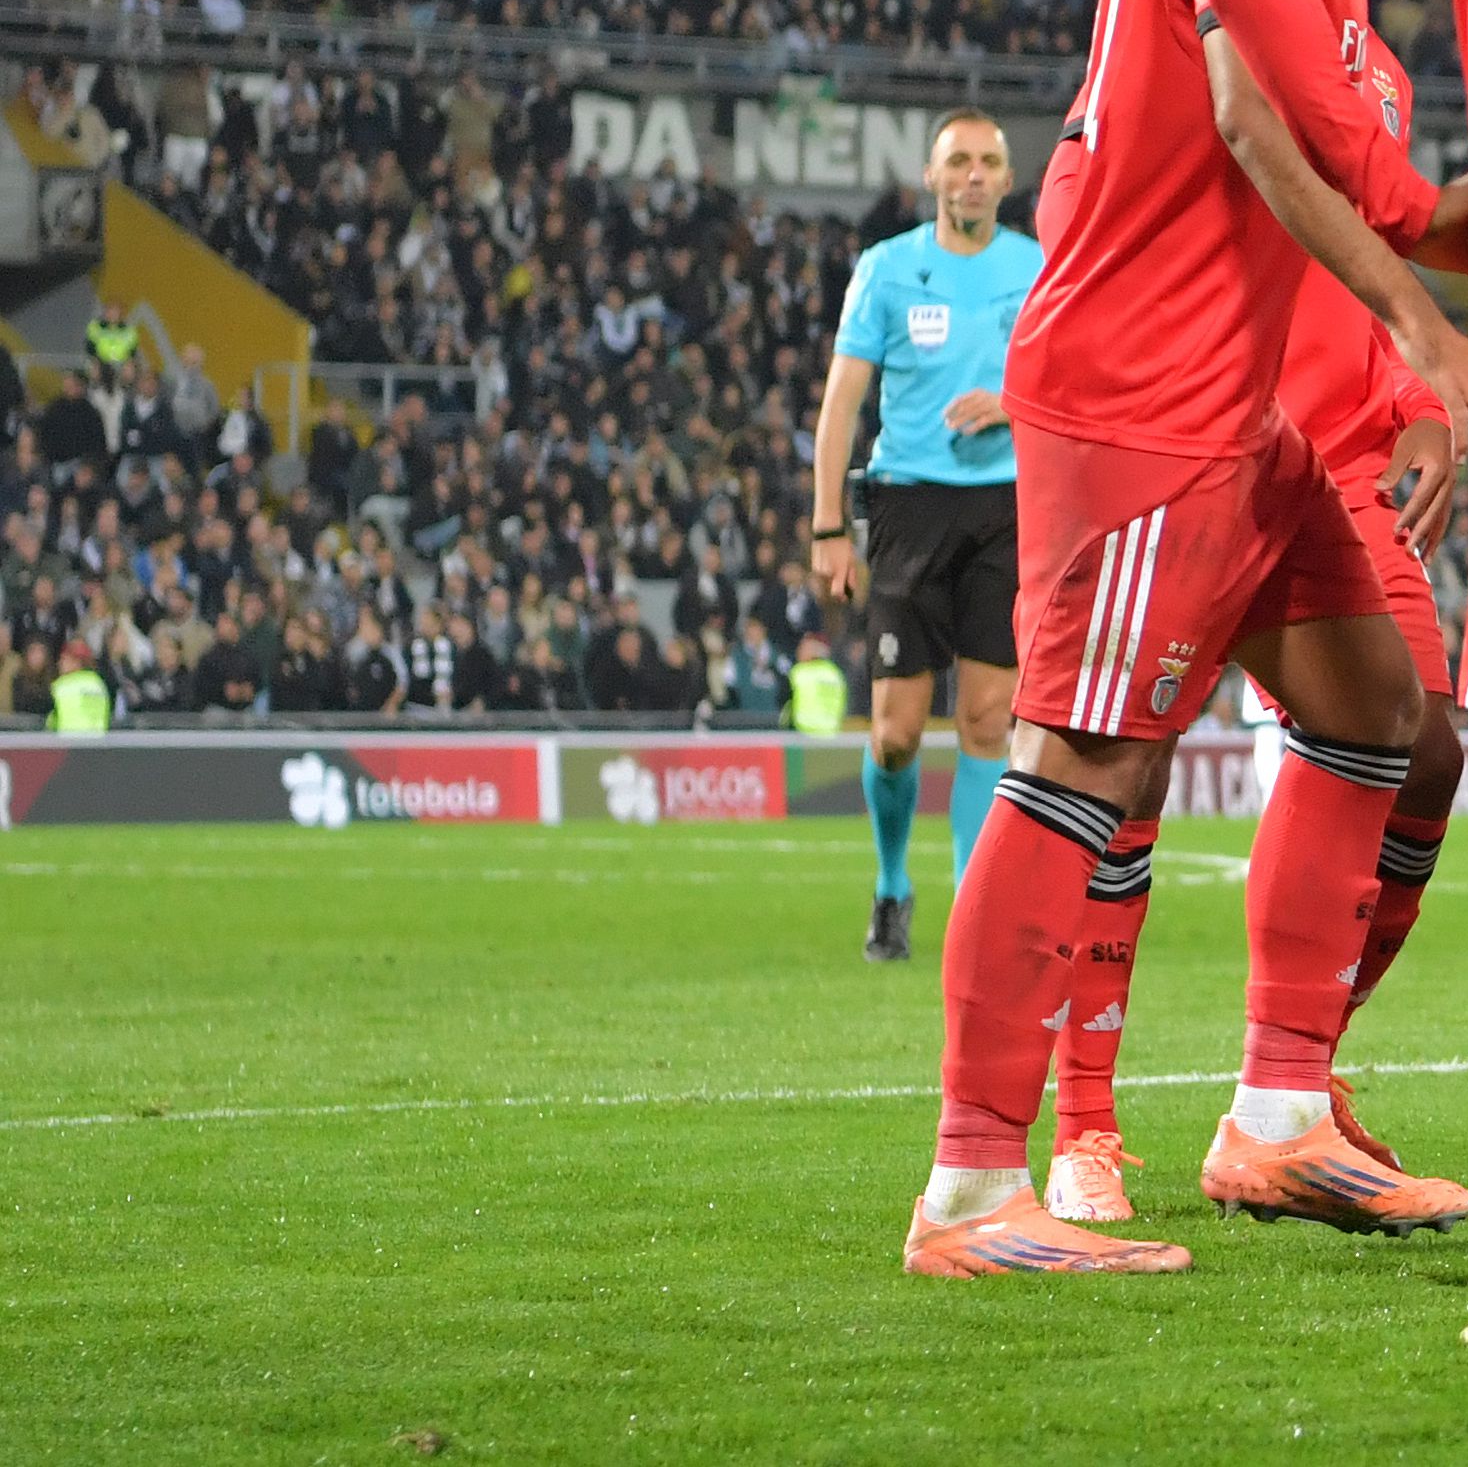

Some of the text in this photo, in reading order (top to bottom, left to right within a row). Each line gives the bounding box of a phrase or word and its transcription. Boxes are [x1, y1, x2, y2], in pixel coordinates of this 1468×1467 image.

[570, 89, 934, 189] DA NEN
[355, 773, 500, 819] totobola
